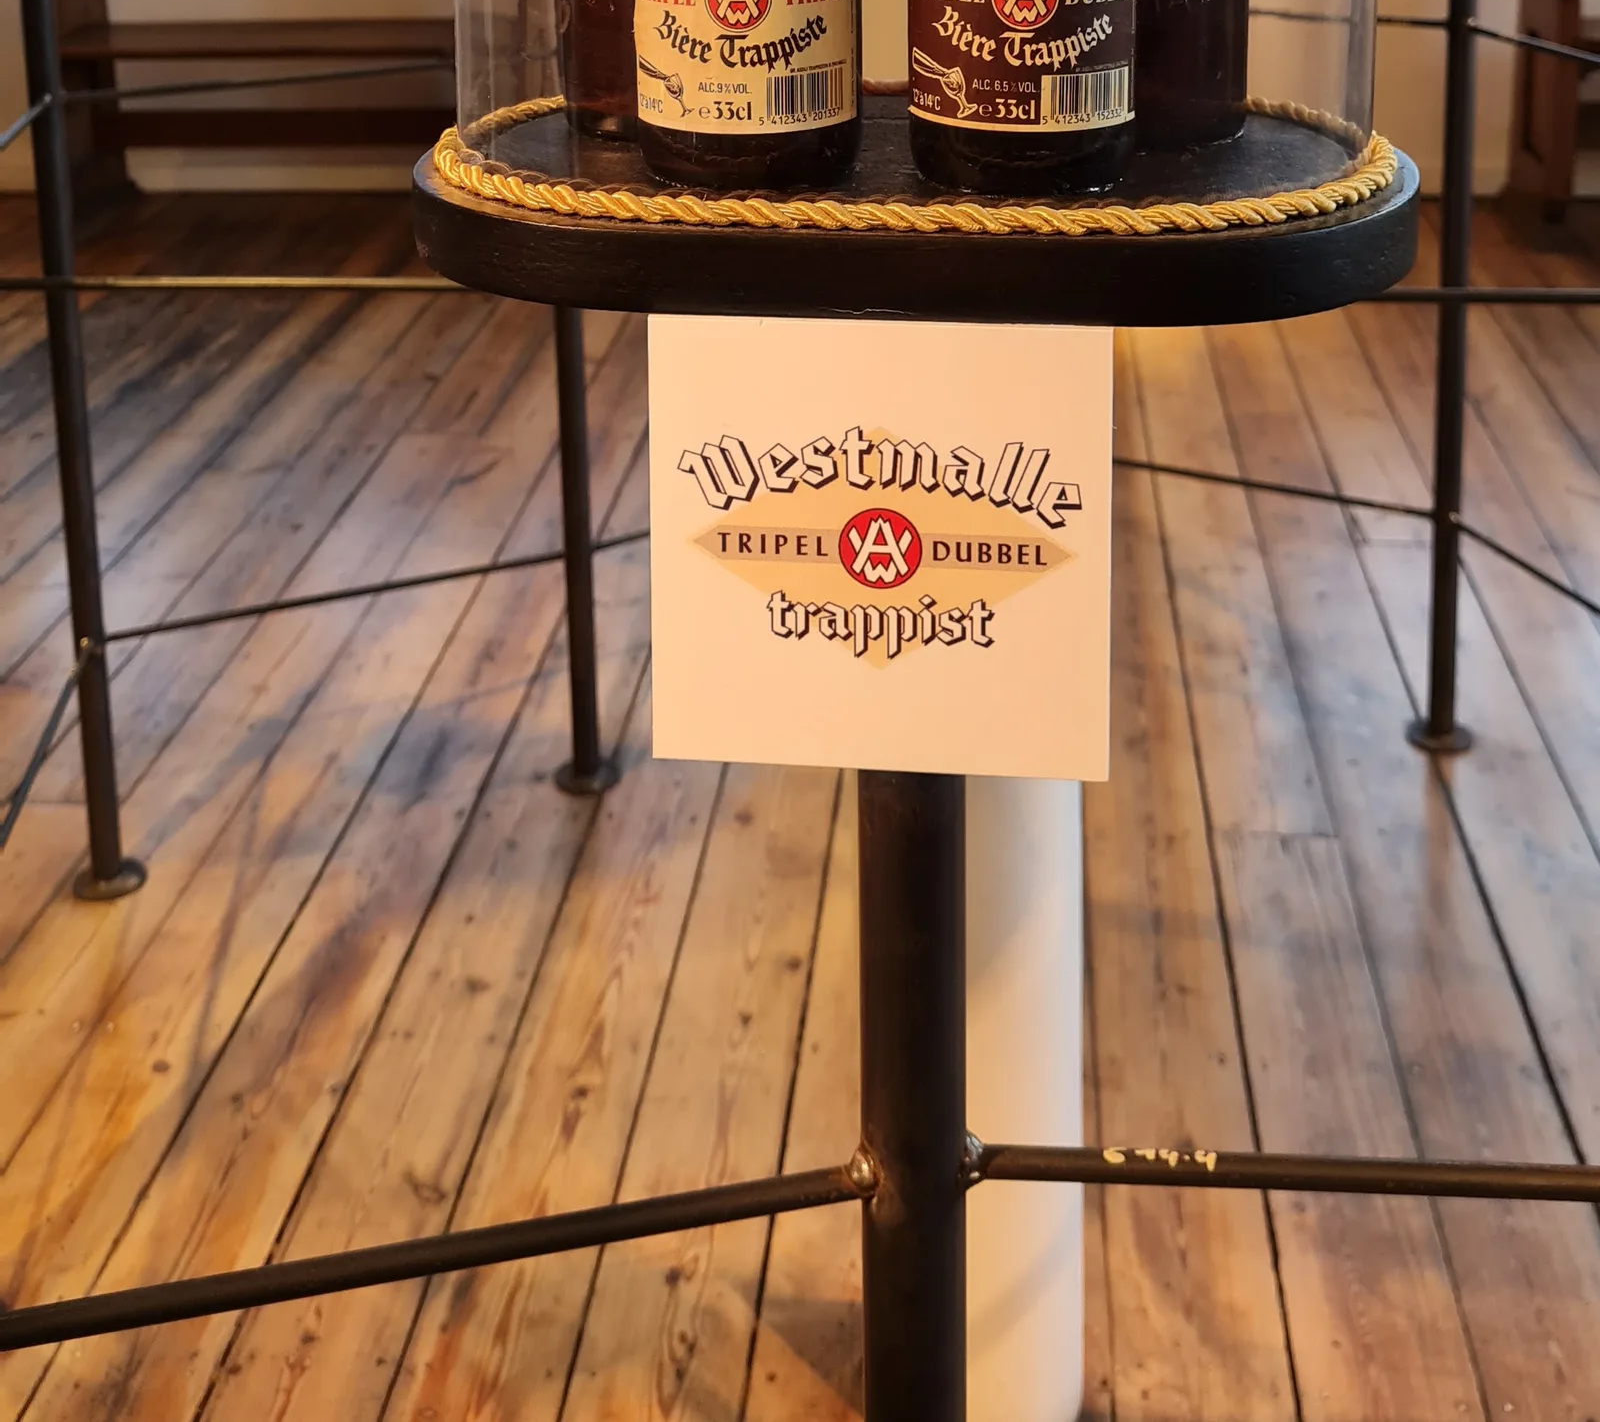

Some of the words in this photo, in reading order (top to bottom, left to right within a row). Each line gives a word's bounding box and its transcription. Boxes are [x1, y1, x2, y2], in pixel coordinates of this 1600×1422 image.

[653, 10, 712, 63] Bière
[714, 14, 827, 73] Trappiste
[932, 5, 997, 62] Bière
[999, 13, 1113, 73] Trappiste
[676, 425, 1083, 529] Westmalle
[717, 532, 829, 557] TRIPEL
[932, 540, 1048, 567] DUBBEL
[766, 590, 995, 659] trappist
